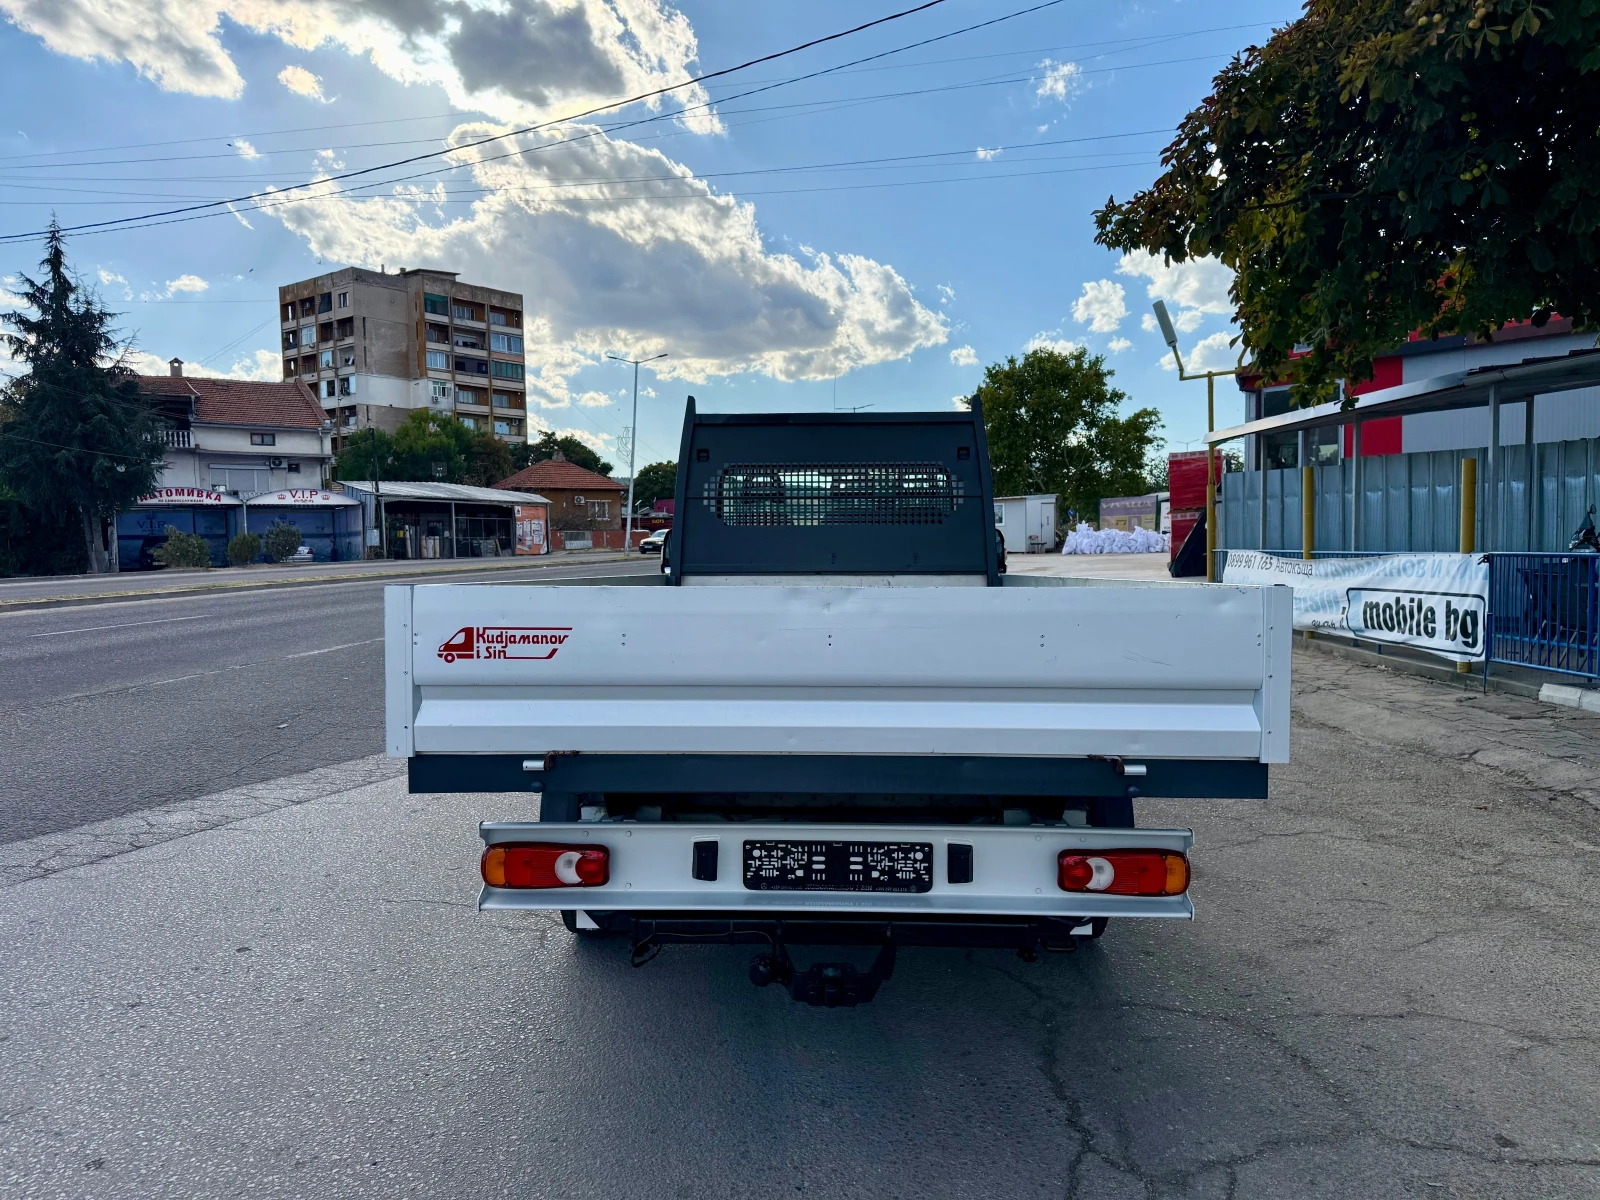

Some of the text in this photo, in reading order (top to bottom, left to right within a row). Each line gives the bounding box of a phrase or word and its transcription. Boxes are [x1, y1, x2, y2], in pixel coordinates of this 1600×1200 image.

[1101, 500, 1153, 509] VIVALUX
[1227, 553, 1245, 568] 0899
[1244, 554, 1256, 570] 961
[1257, 556, 1273, 571] 165
[1273, 558, 1313, 577] Автокъща
[476, 627, 570, 649] Kudjamanov
[483, 646, 507, 659] Sin
